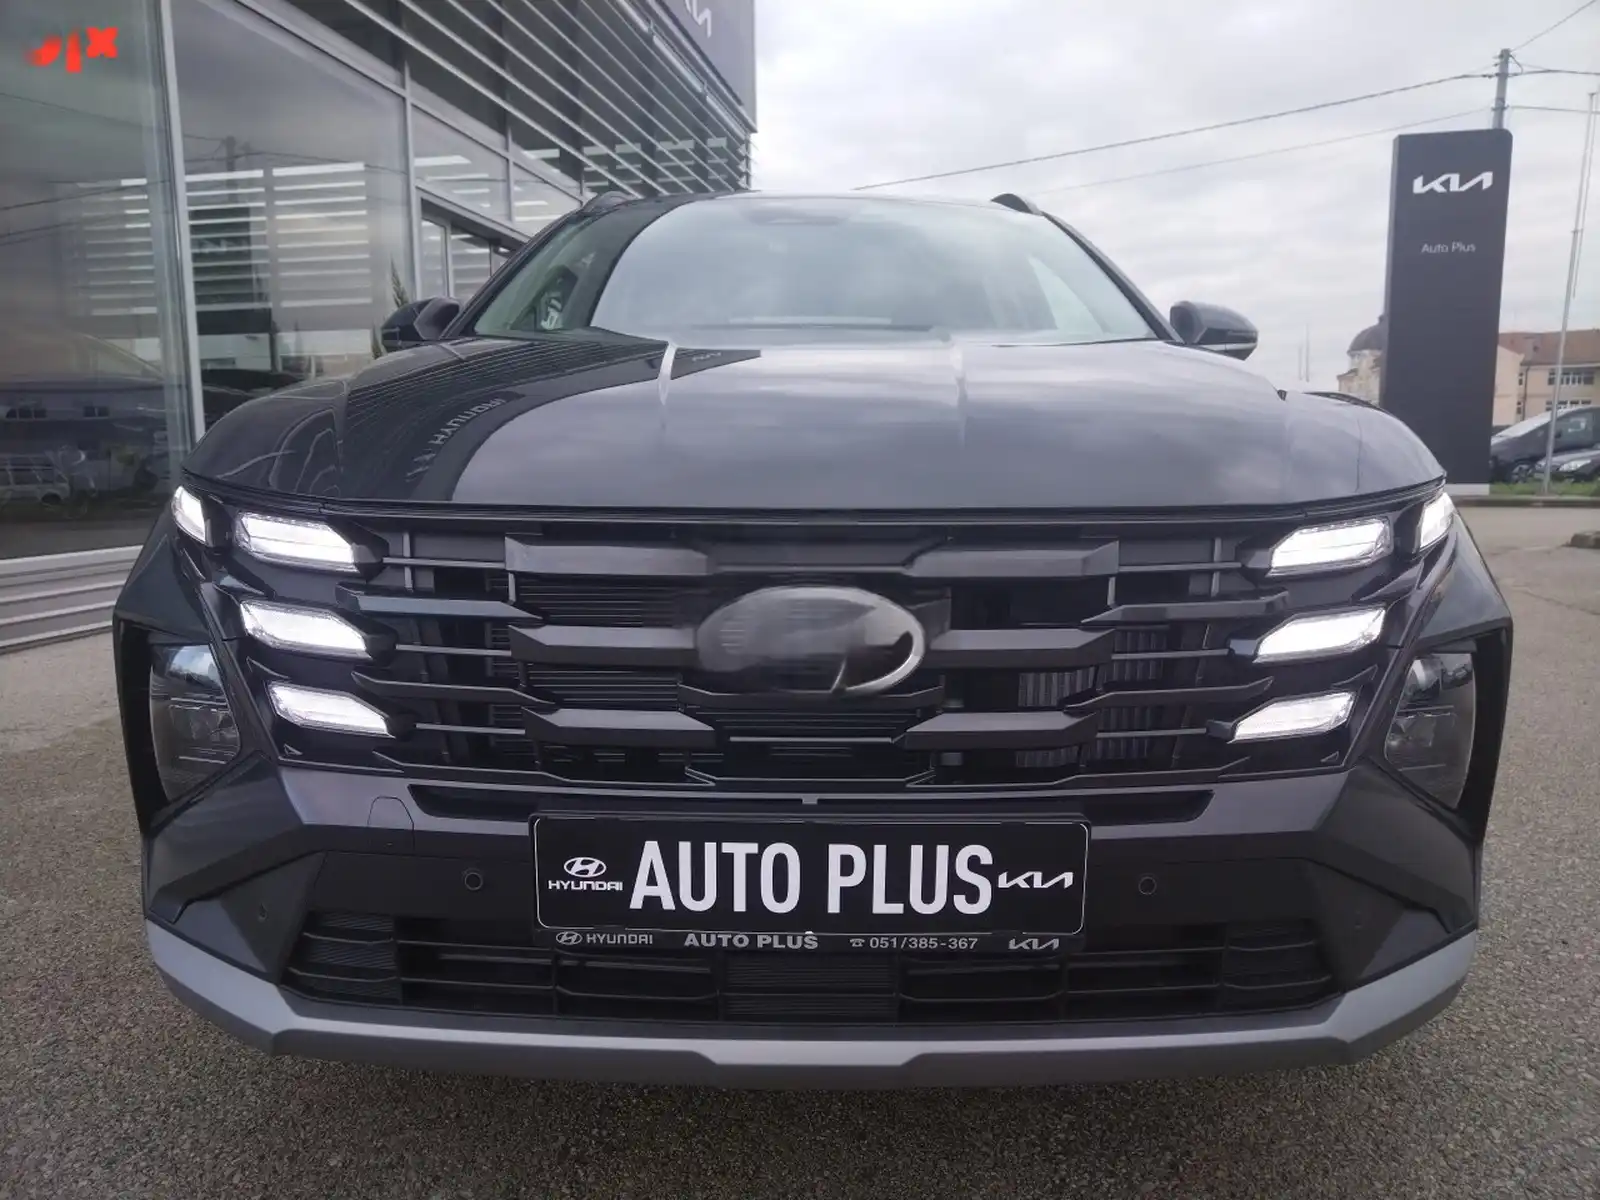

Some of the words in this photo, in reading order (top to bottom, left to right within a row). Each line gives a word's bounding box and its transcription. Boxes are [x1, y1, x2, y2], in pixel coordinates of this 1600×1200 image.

[1412, 171, 1494, 194] KIA
[1421, 243, 1449, 254] Auto
[1451, 240, 1476, 253] Plus
[629, 840, 801, 914] AUTO
[827, 843, 993, 915] PLUS
[997, 871, 1074, 889] KIA
[548, 880, 623, 891] HYUNDAI
[586, 933, 653, 945] HYUNDAI
[684, 933, 749, 948] AUTO
[757, 935, 819, 950] PLUS
[869, 937, 978, 950] 051/385-367
[1008, 938, 1060, 950] KIA
